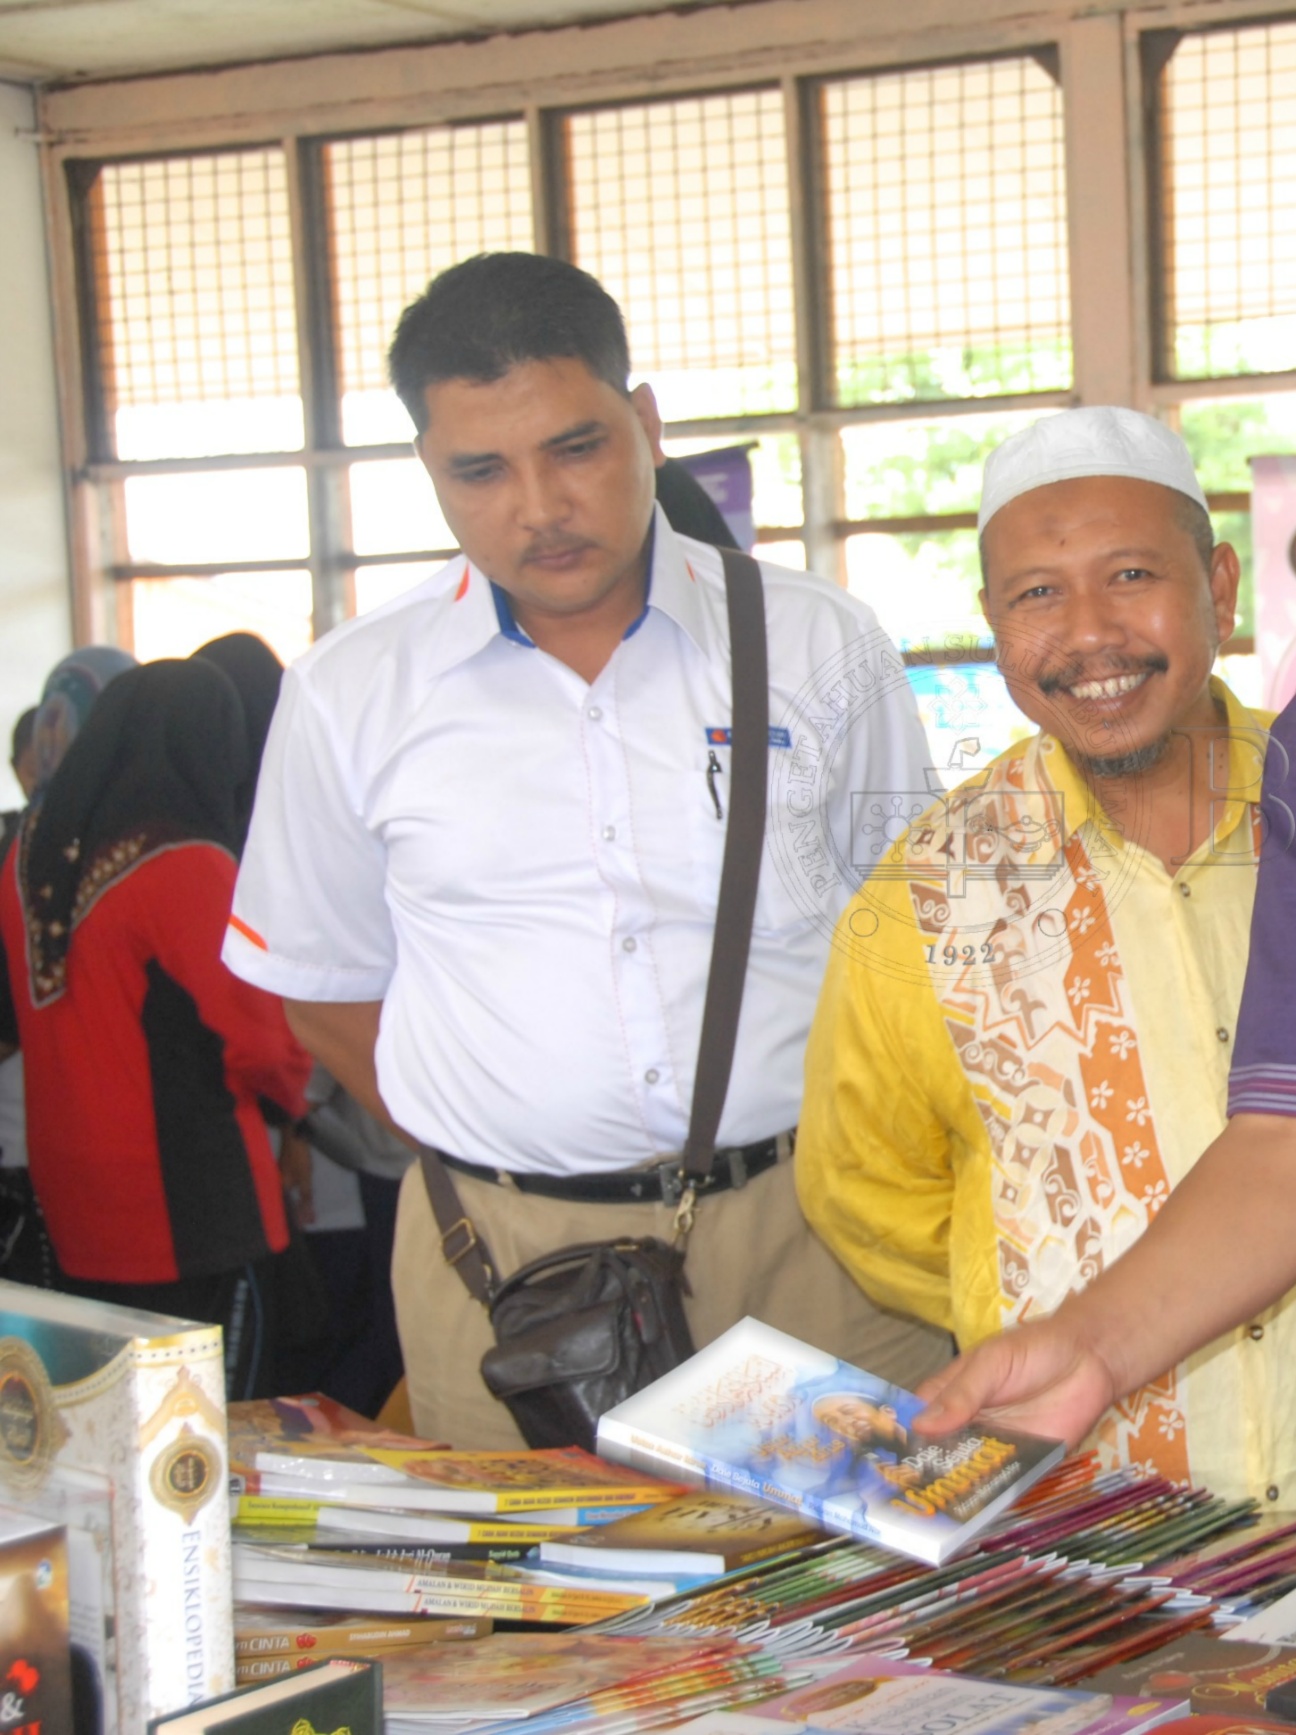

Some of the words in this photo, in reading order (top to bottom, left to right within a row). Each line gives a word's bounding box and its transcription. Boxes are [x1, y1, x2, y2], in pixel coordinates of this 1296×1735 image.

[182, 1529, 205, 1706] ENSIKLOPEDIA
[249, 1634, 290, 1652] CINTA
[250, 1660, 291, 1676] CINTA
